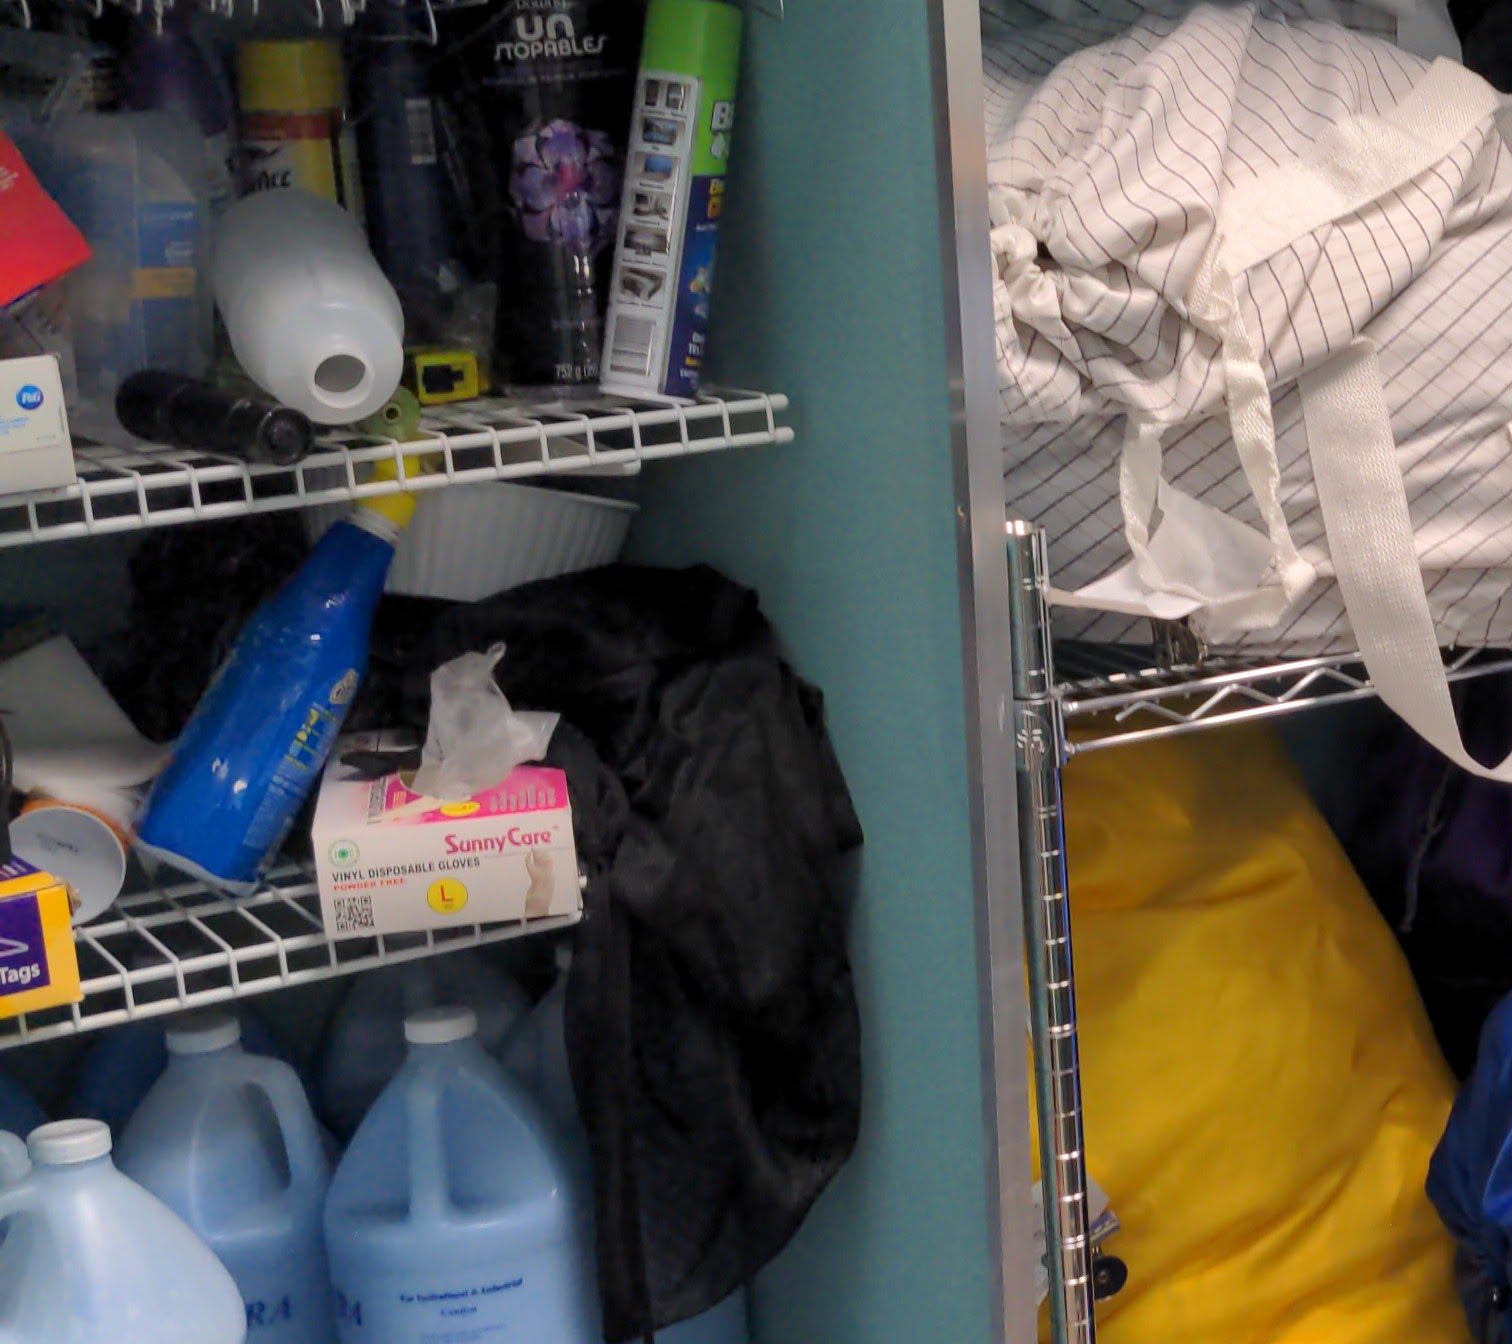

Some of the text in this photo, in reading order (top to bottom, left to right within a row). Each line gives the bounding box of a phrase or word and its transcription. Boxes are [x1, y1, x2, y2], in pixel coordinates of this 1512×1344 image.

[332, 856, 481, 883] VINYL DISPOSABLE GLOVES
[333, 877, 407, 892] POWDER FREE
[440, 885, 455, 903] L
[0, 962, 41, 985] Tags
